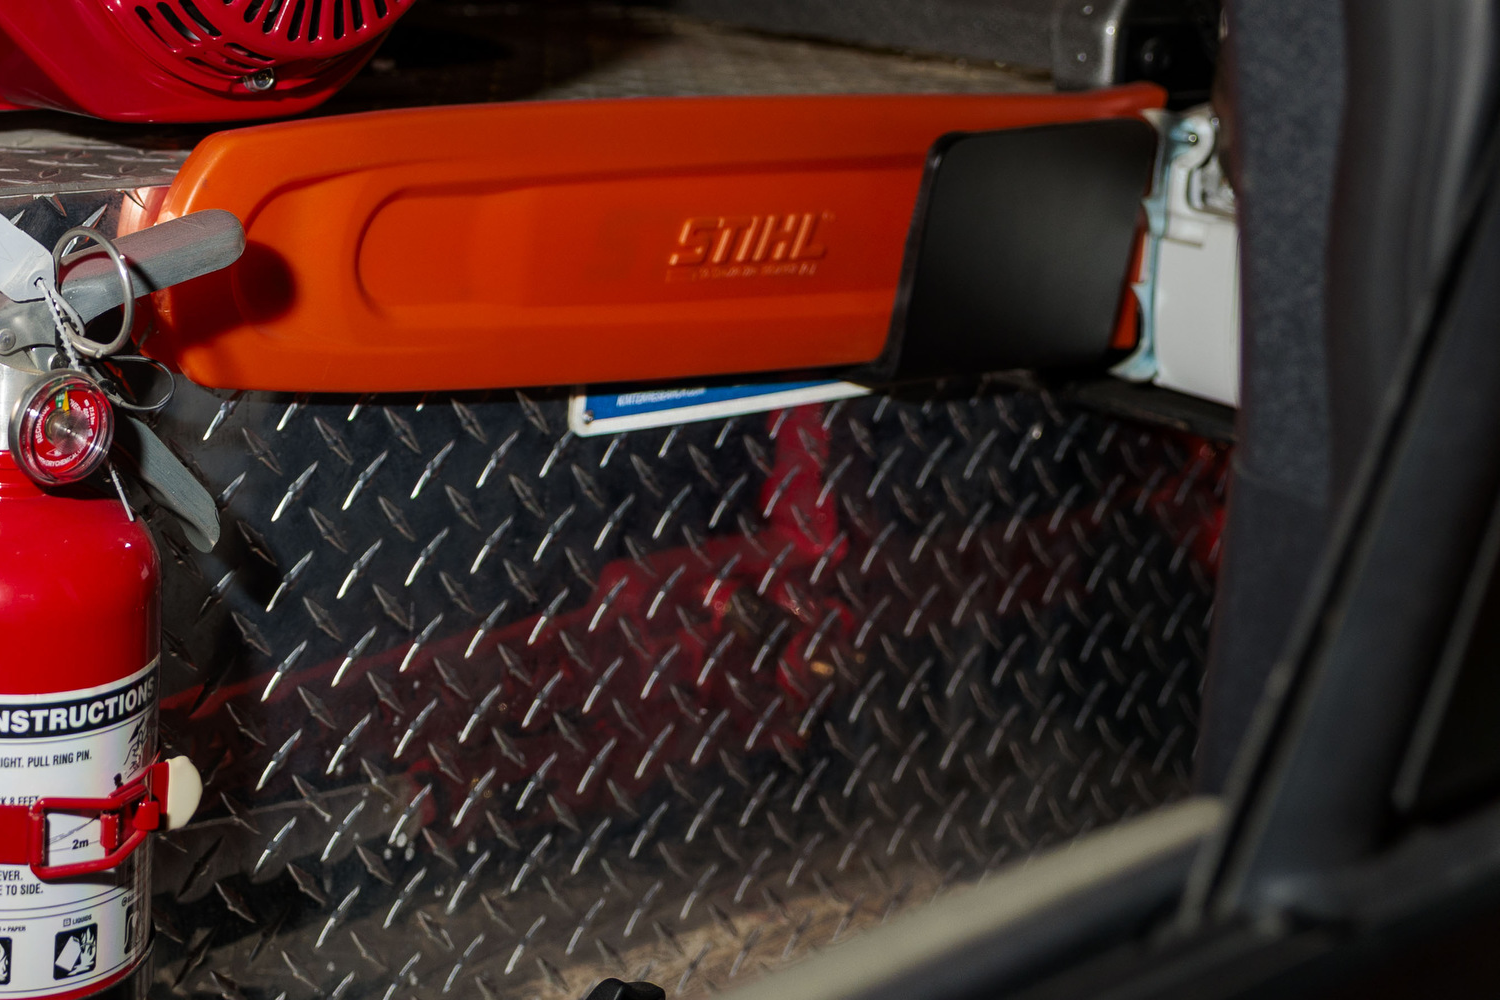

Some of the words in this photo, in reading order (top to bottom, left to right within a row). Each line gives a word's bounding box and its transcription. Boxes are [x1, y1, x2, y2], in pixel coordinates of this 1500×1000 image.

[668, 213, 828, 266] STIHL
[27, 756, 50, 768] PULL
[53, 753, 74, 766] RING
[76, 749, 92, 761] PIN.
[72, 839, 89, 849] 2m
[6, 884, 17, 896] TO
[20, 883, 44, 895] SIDE.
